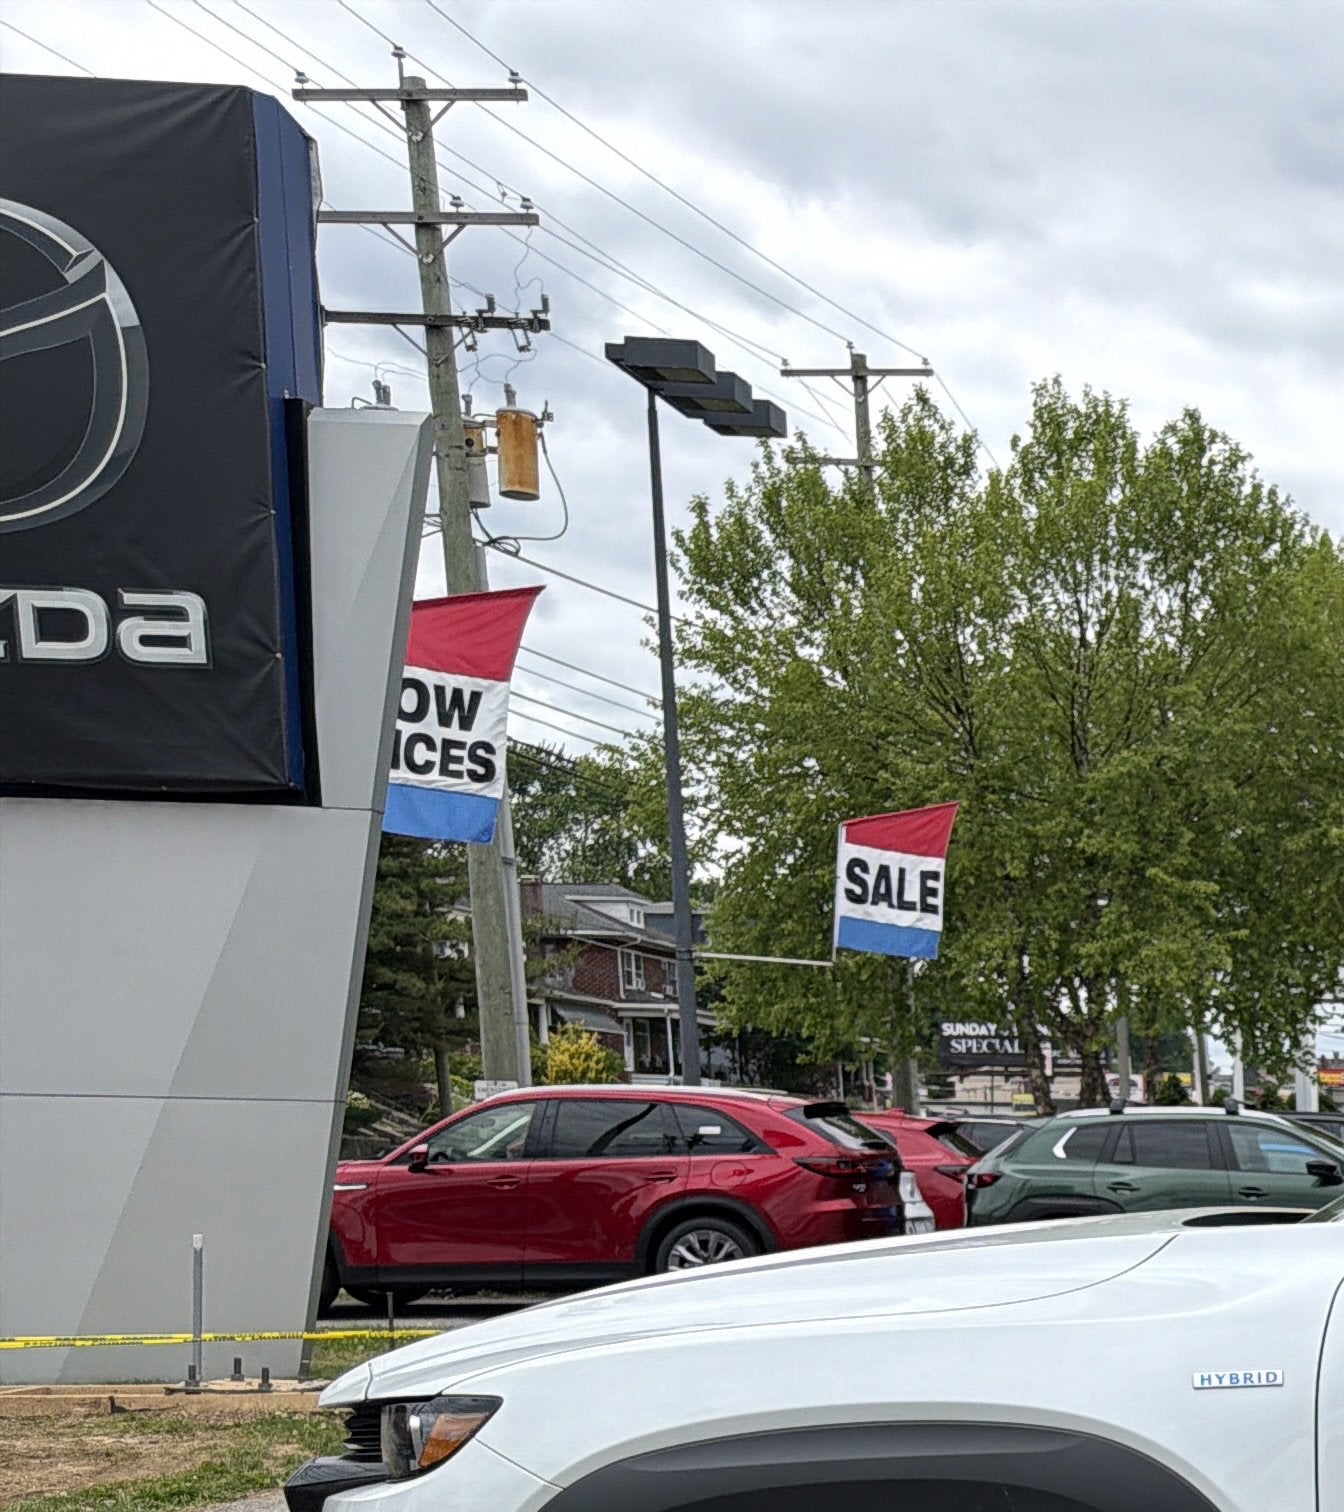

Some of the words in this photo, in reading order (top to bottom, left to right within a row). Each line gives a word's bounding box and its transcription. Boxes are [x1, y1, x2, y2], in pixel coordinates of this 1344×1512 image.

[396, 677, 484, 732] OW
[390, 728, 497, 784] ICES
[844, 857, 941, 916] SALE
[941, 1022, 998, 1036] SUNDAY
[950, 1038, 1025, 1054] SPECIAL
[1199, 1371, 1278, 1386] HYBRID
